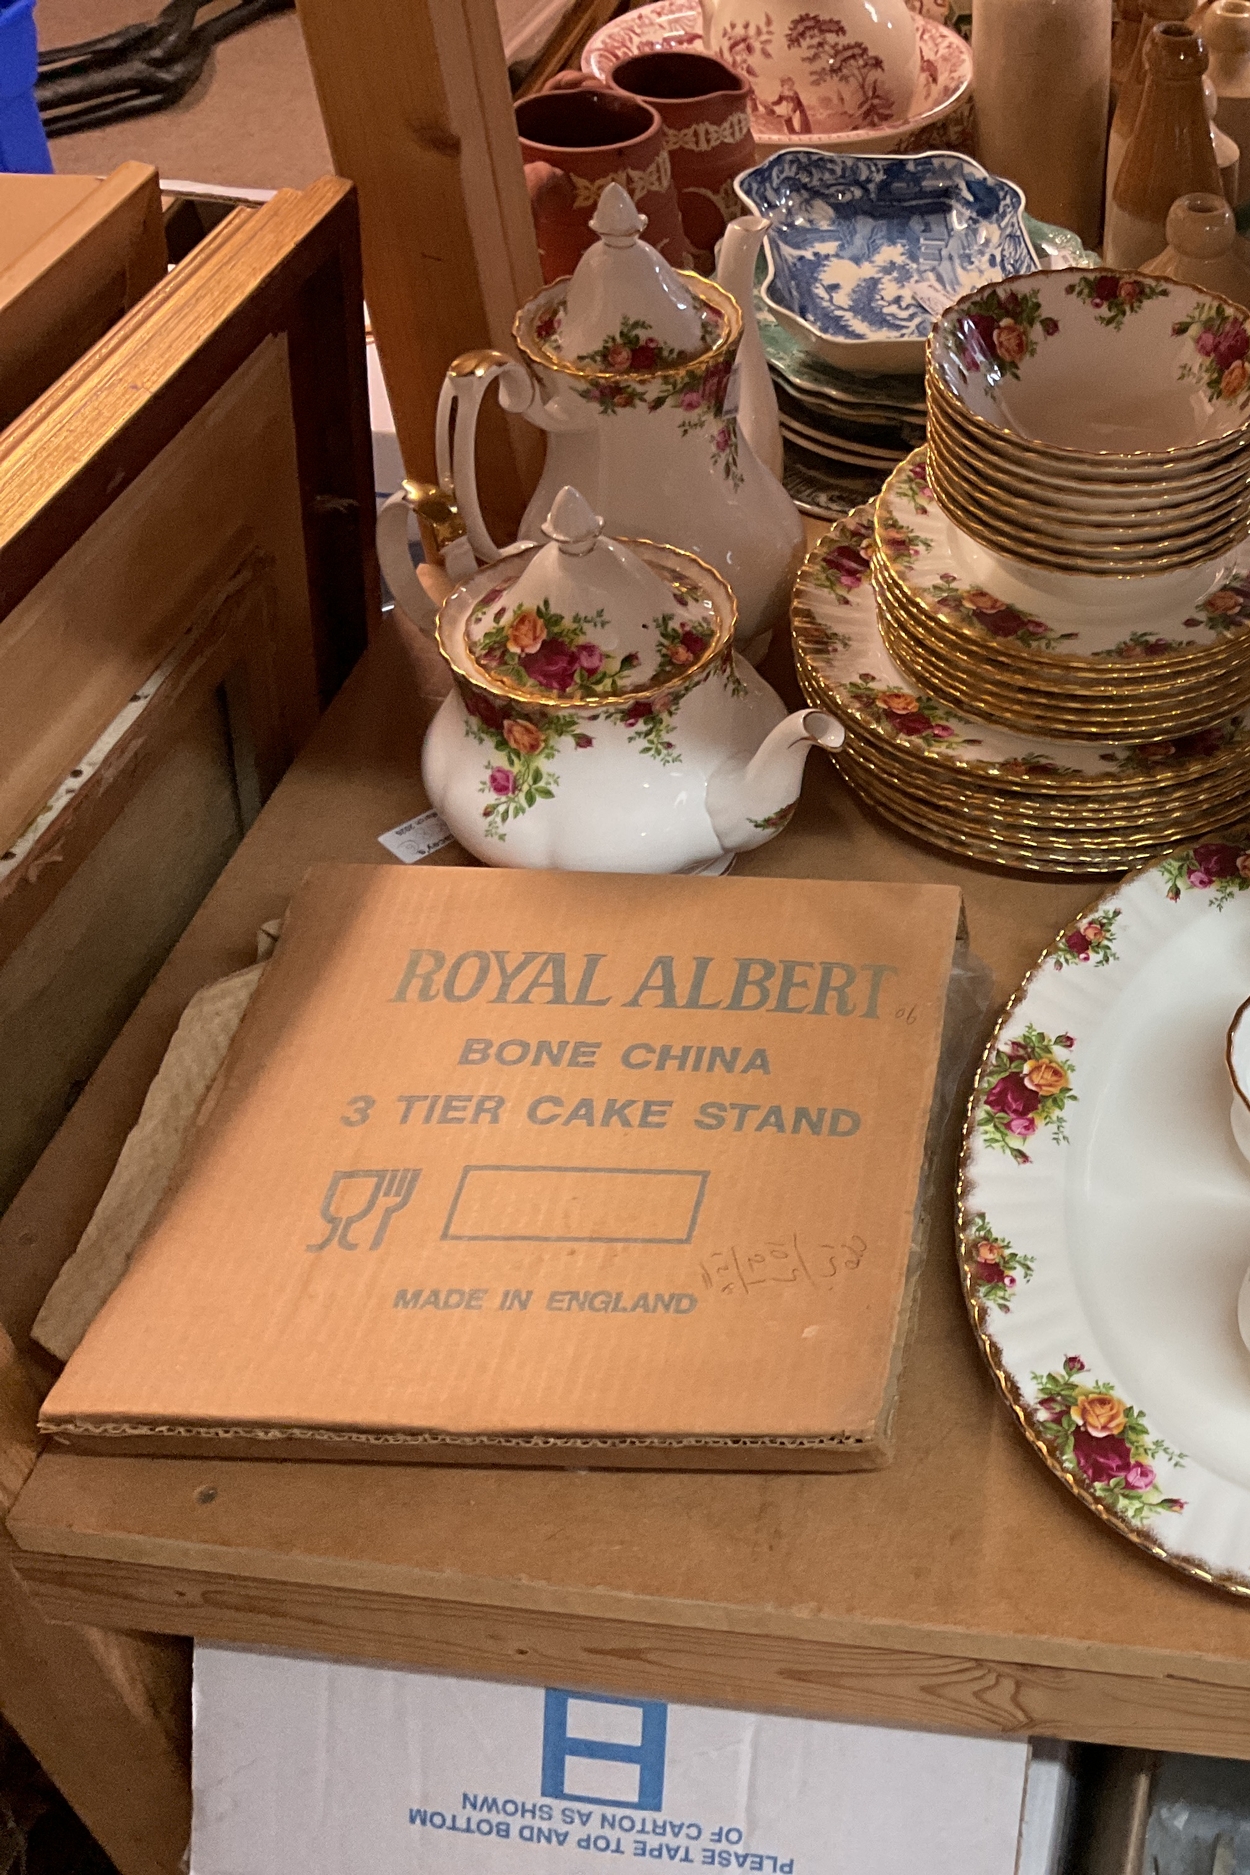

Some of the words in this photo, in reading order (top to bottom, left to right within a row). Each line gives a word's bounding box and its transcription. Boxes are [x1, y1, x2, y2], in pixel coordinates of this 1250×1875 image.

[388, 949, 612, 1007] ROYAL
[620, 955, 899, 1019] ALBERT
[457, 1038, 602, 1068] BONE
[620, 1043, 771, 1075] CHINA
[340, 1094, 376, 1128] 3
[396, 1094, 506, 1125] TIER
[526, 1095, 674, 1129] CAKE
[694, 1101, 861, 1137] STAND
[393, 1288, 488, 1311] MADE
[500, 1289, 534, 1311] IN
[545, 1290, 699, 1315] ENGLAND
[462, 1792, 553, 1821] SHOWN
[561, 1807, 593, 1827] AS
[409, 1808, 510, 1839] BOTTOM
[519, 1824, 569, 1846] AND
[601, 1813, 702, 1841] CARTON
[709, 1826, 743, 1845] OF
[577, 1833, 625, 1855] TOP
[633, 1839, 694, 1863] TAPE
[702, 1848, 795, 1875] PLEASE
